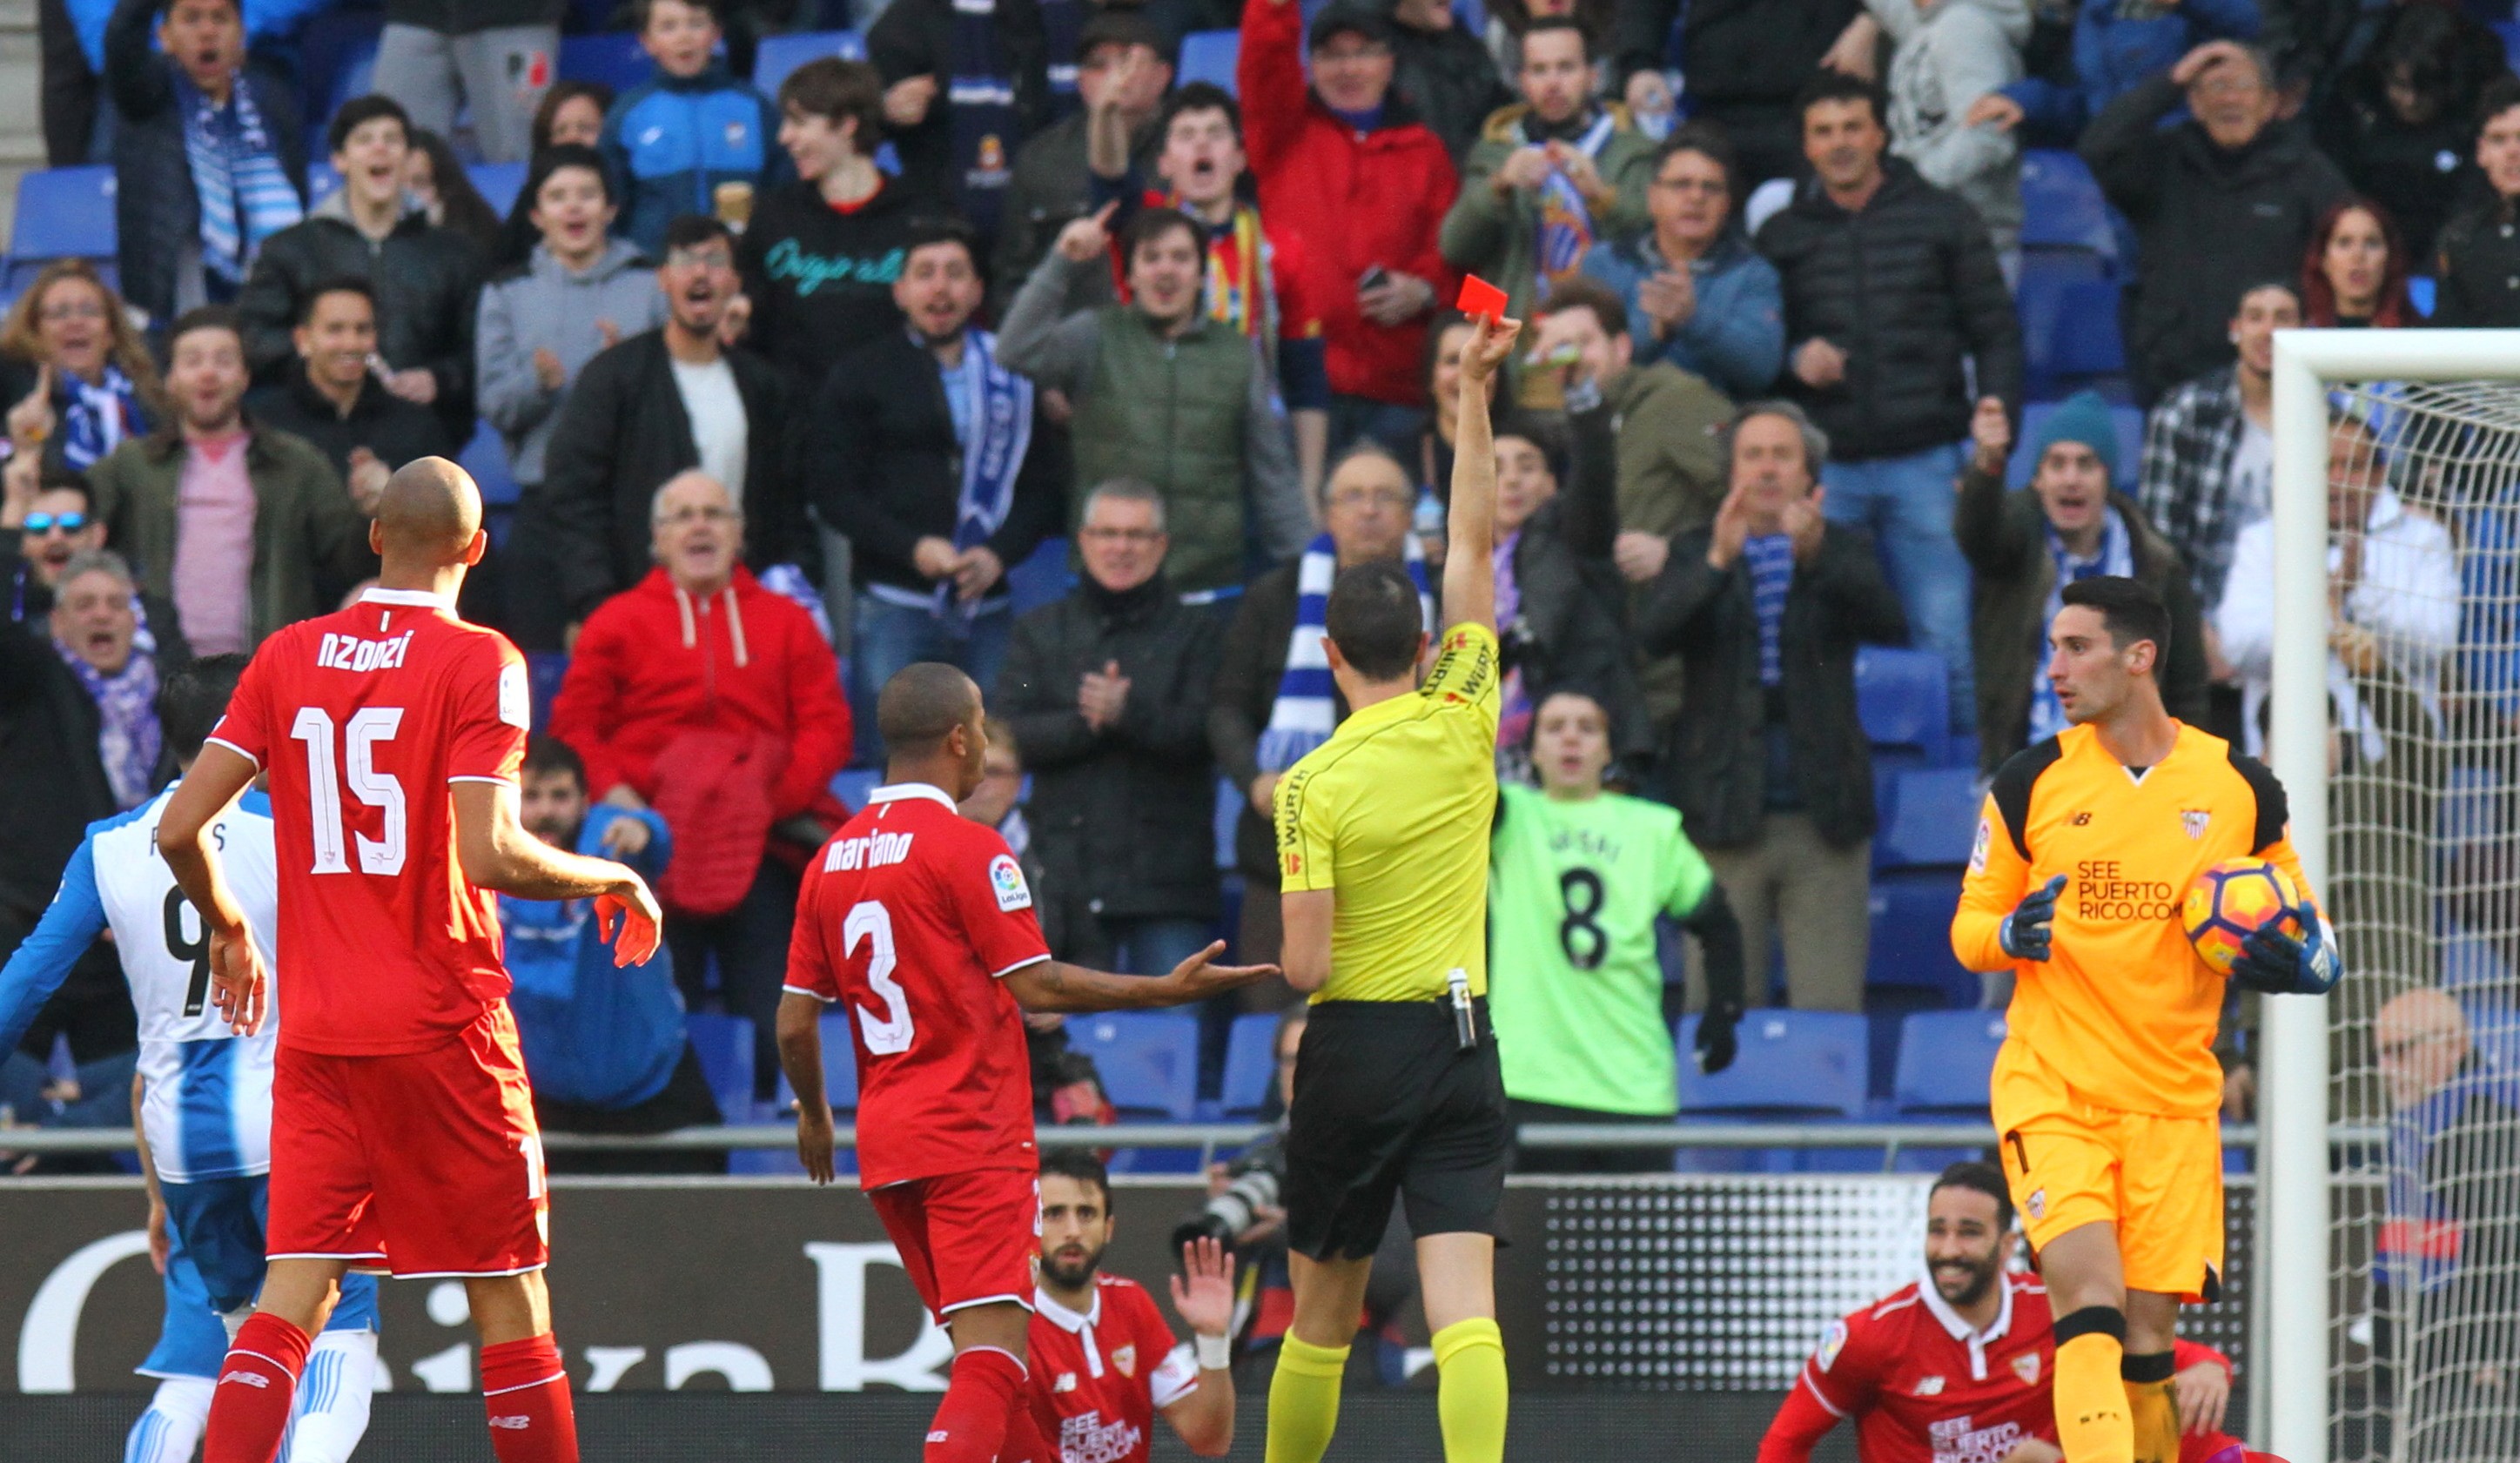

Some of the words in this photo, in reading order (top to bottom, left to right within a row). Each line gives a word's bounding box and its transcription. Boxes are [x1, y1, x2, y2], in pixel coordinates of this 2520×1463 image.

[290, 707, 407, 876] 15
[2078, 861, 2120, 880] SEE
[2079, 882, 2172, 900] PUERTO
[1560, 867, 1608, 970] 8
[2080, 902, 2183, 920] RICO.COM
[164, 883, 212, 1017] 9
[843, 897, 915, 1056] 3
[1061, 1409, 1099, 1434] SEE
[1928, 1415, 1972, 1437] SEE
